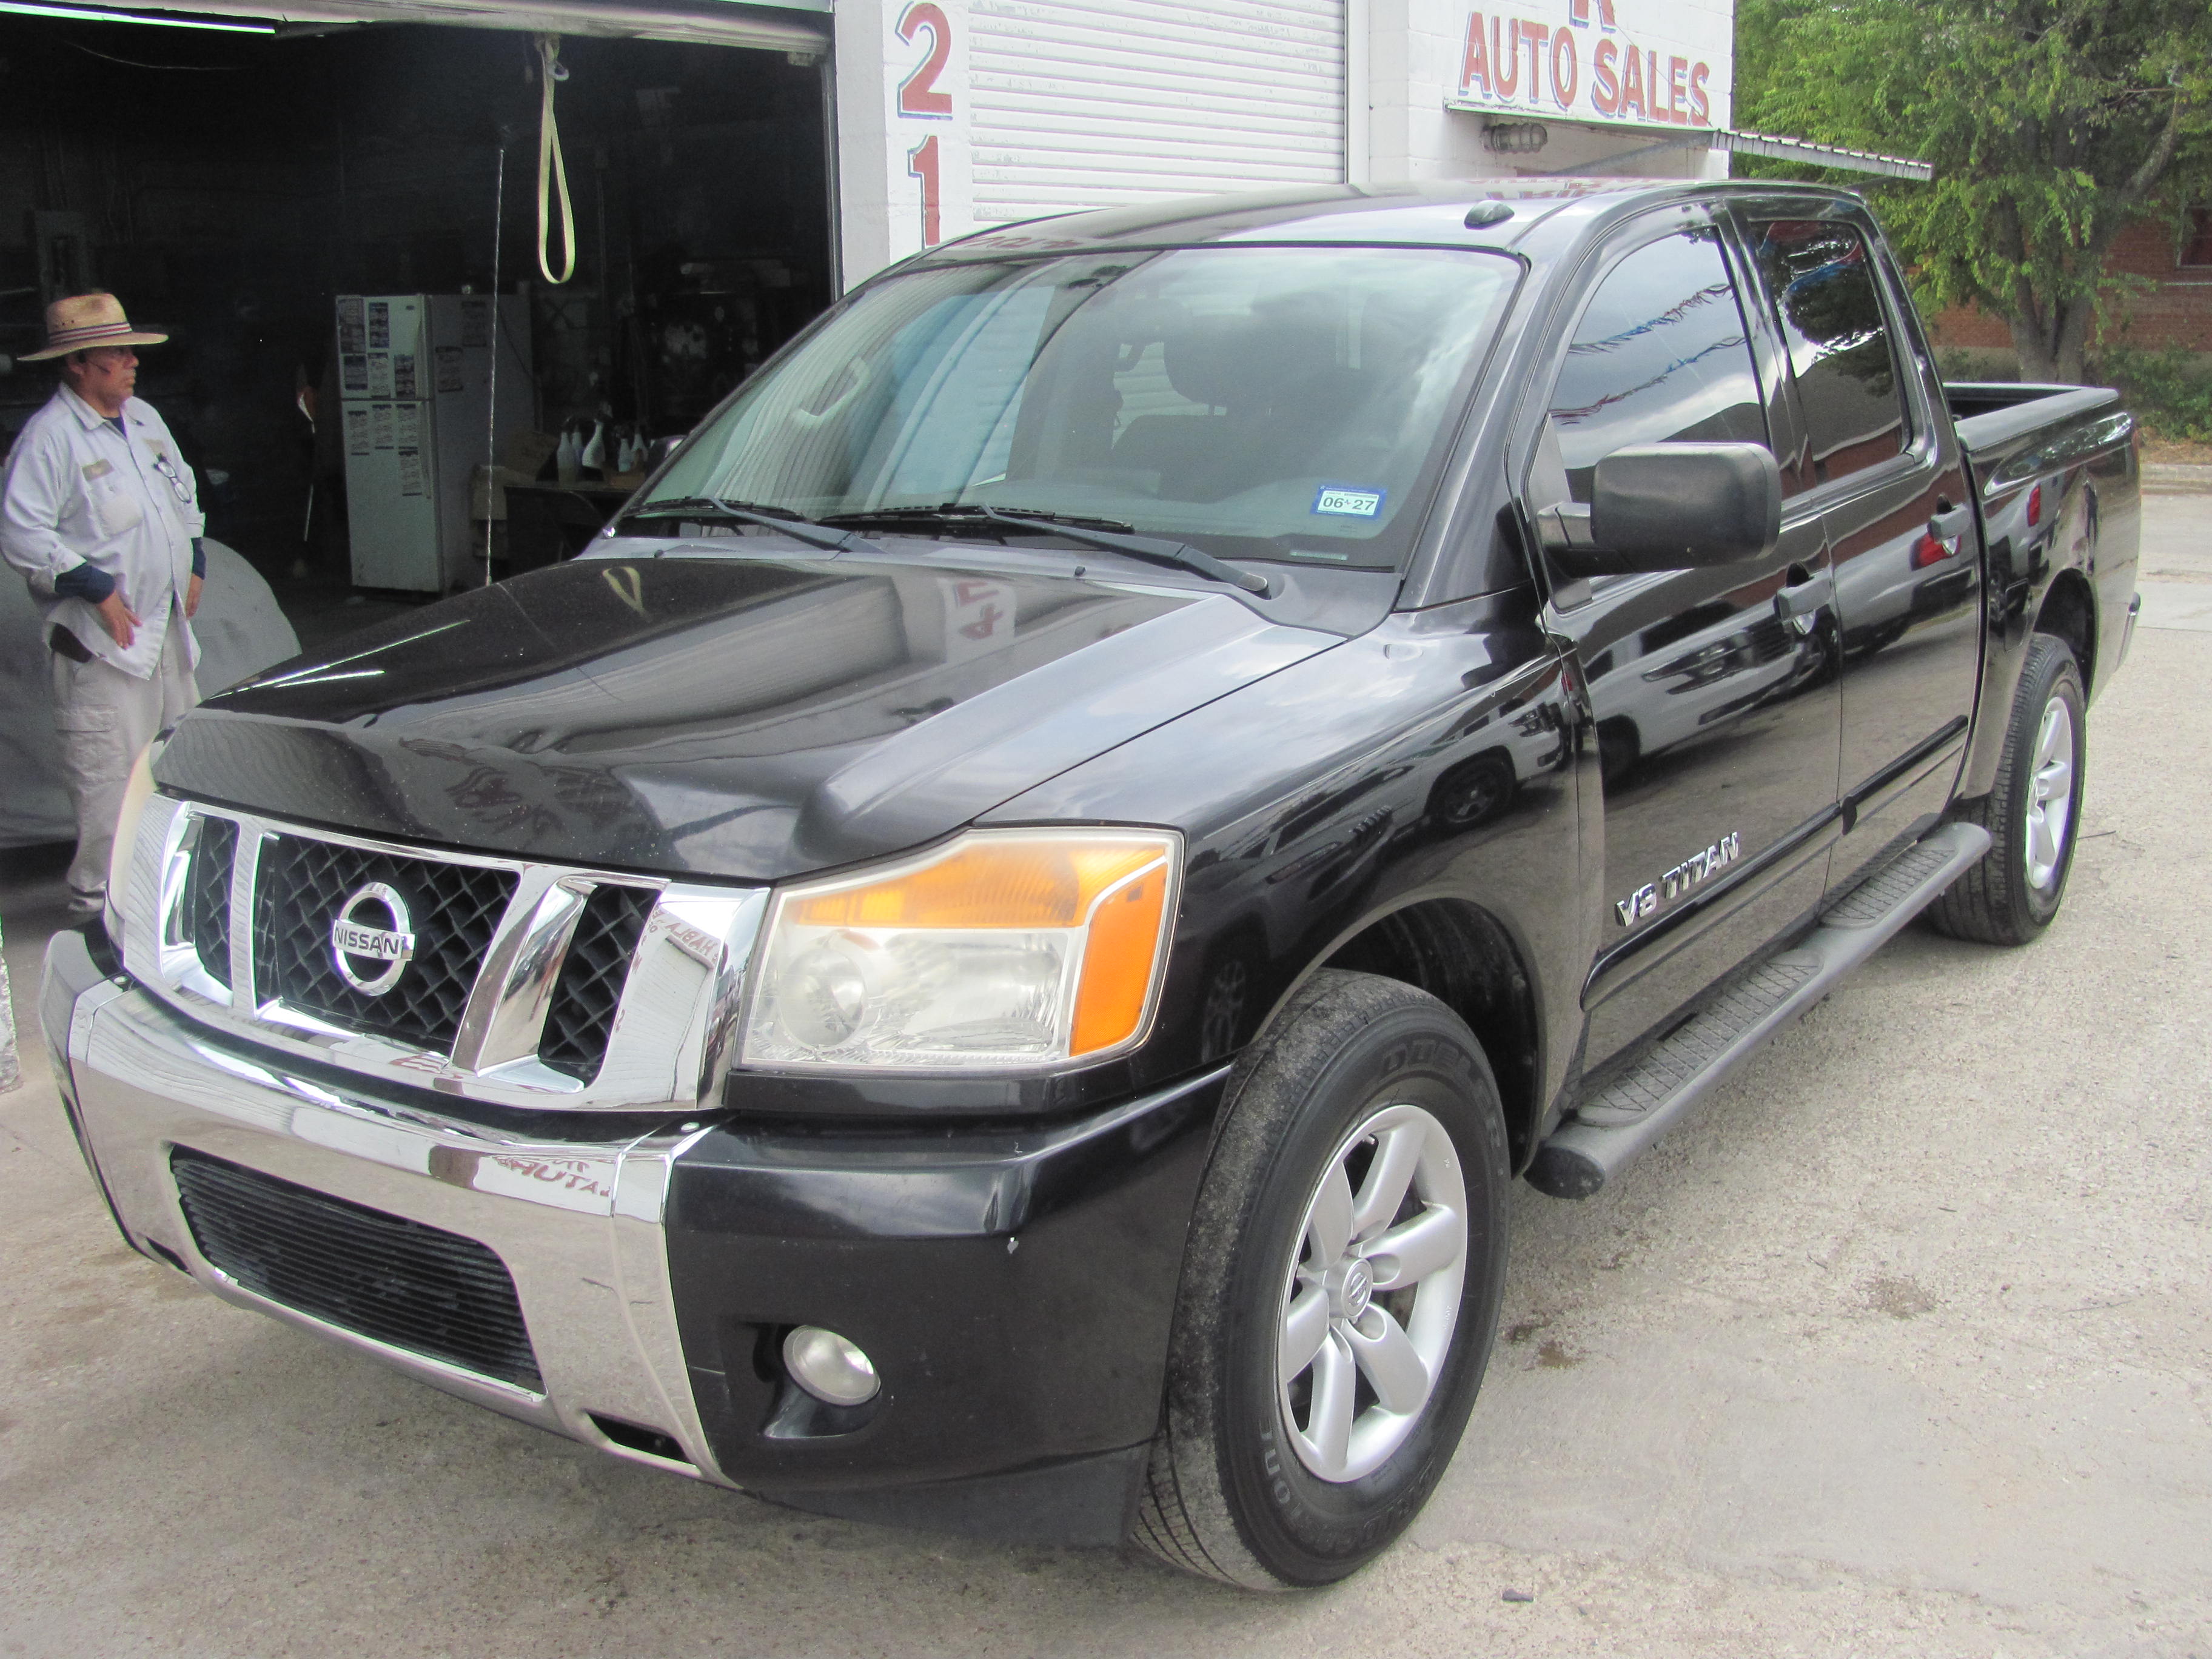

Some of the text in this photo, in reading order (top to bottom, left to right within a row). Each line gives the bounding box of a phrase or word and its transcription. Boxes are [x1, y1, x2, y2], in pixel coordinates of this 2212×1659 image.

[1458, 12, 1710, 126] AUTO SALES
[1322, 497, 1375, 511] 06 27
[1660, 831, 1739, 899] TITAN
[334, 926, 400, 954] NISSAN
